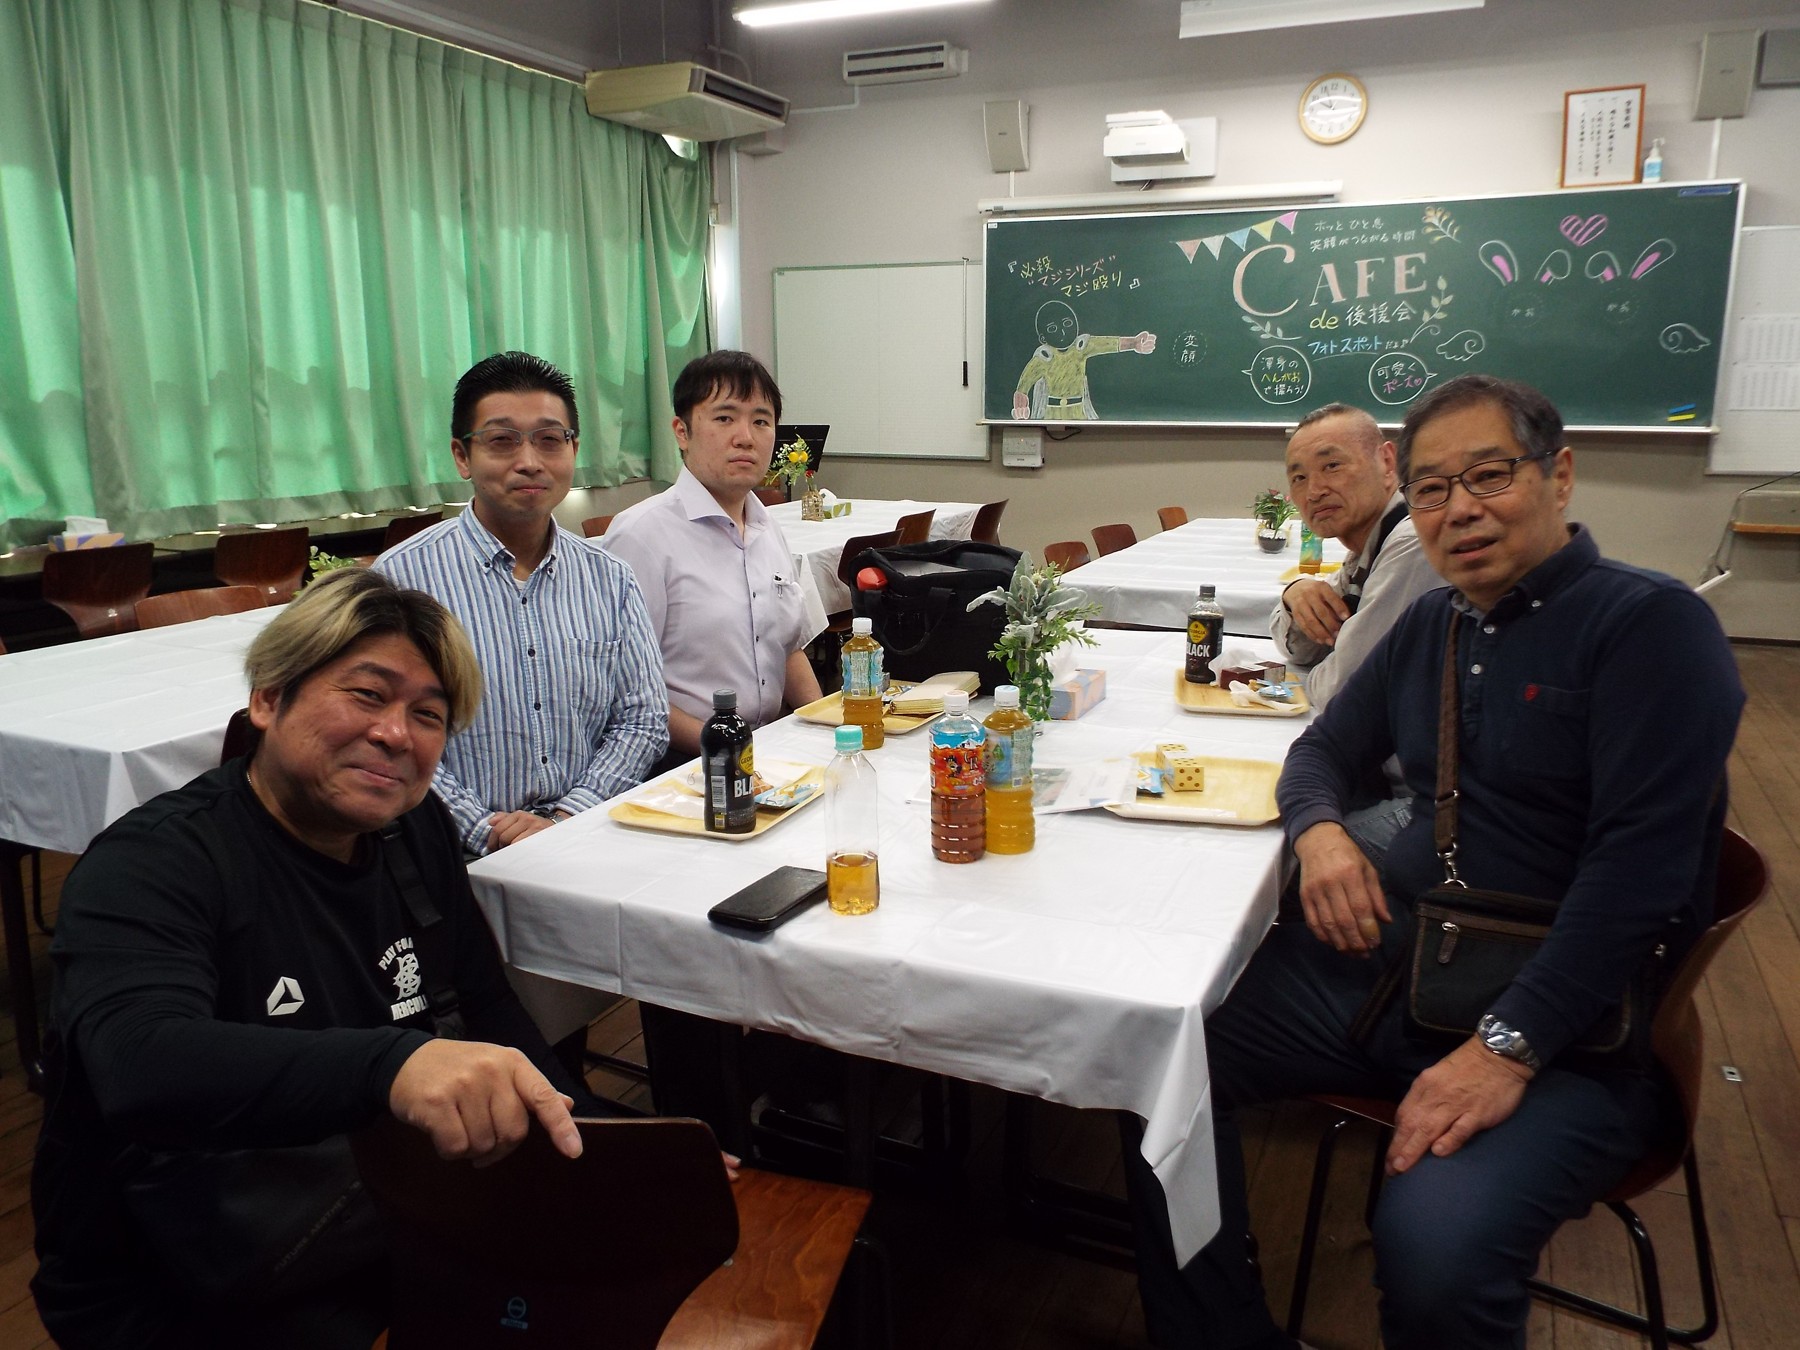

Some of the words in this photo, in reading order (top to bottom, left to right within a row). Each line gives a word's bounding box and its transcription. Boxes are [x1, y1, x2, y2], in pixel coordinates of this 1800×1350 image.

[1232, 243, 1428, 317] CAFE
[1309, 309, 1340, 330] de
[1345, 300, 1418, 328] 後援会
[1180, 334, 1199, 364] 変顔
[1260, 371, 1301, 383] へんがお
[1376, 360, 1417, 380] 可愛く
[378, 945, 397, 971] PLAY
